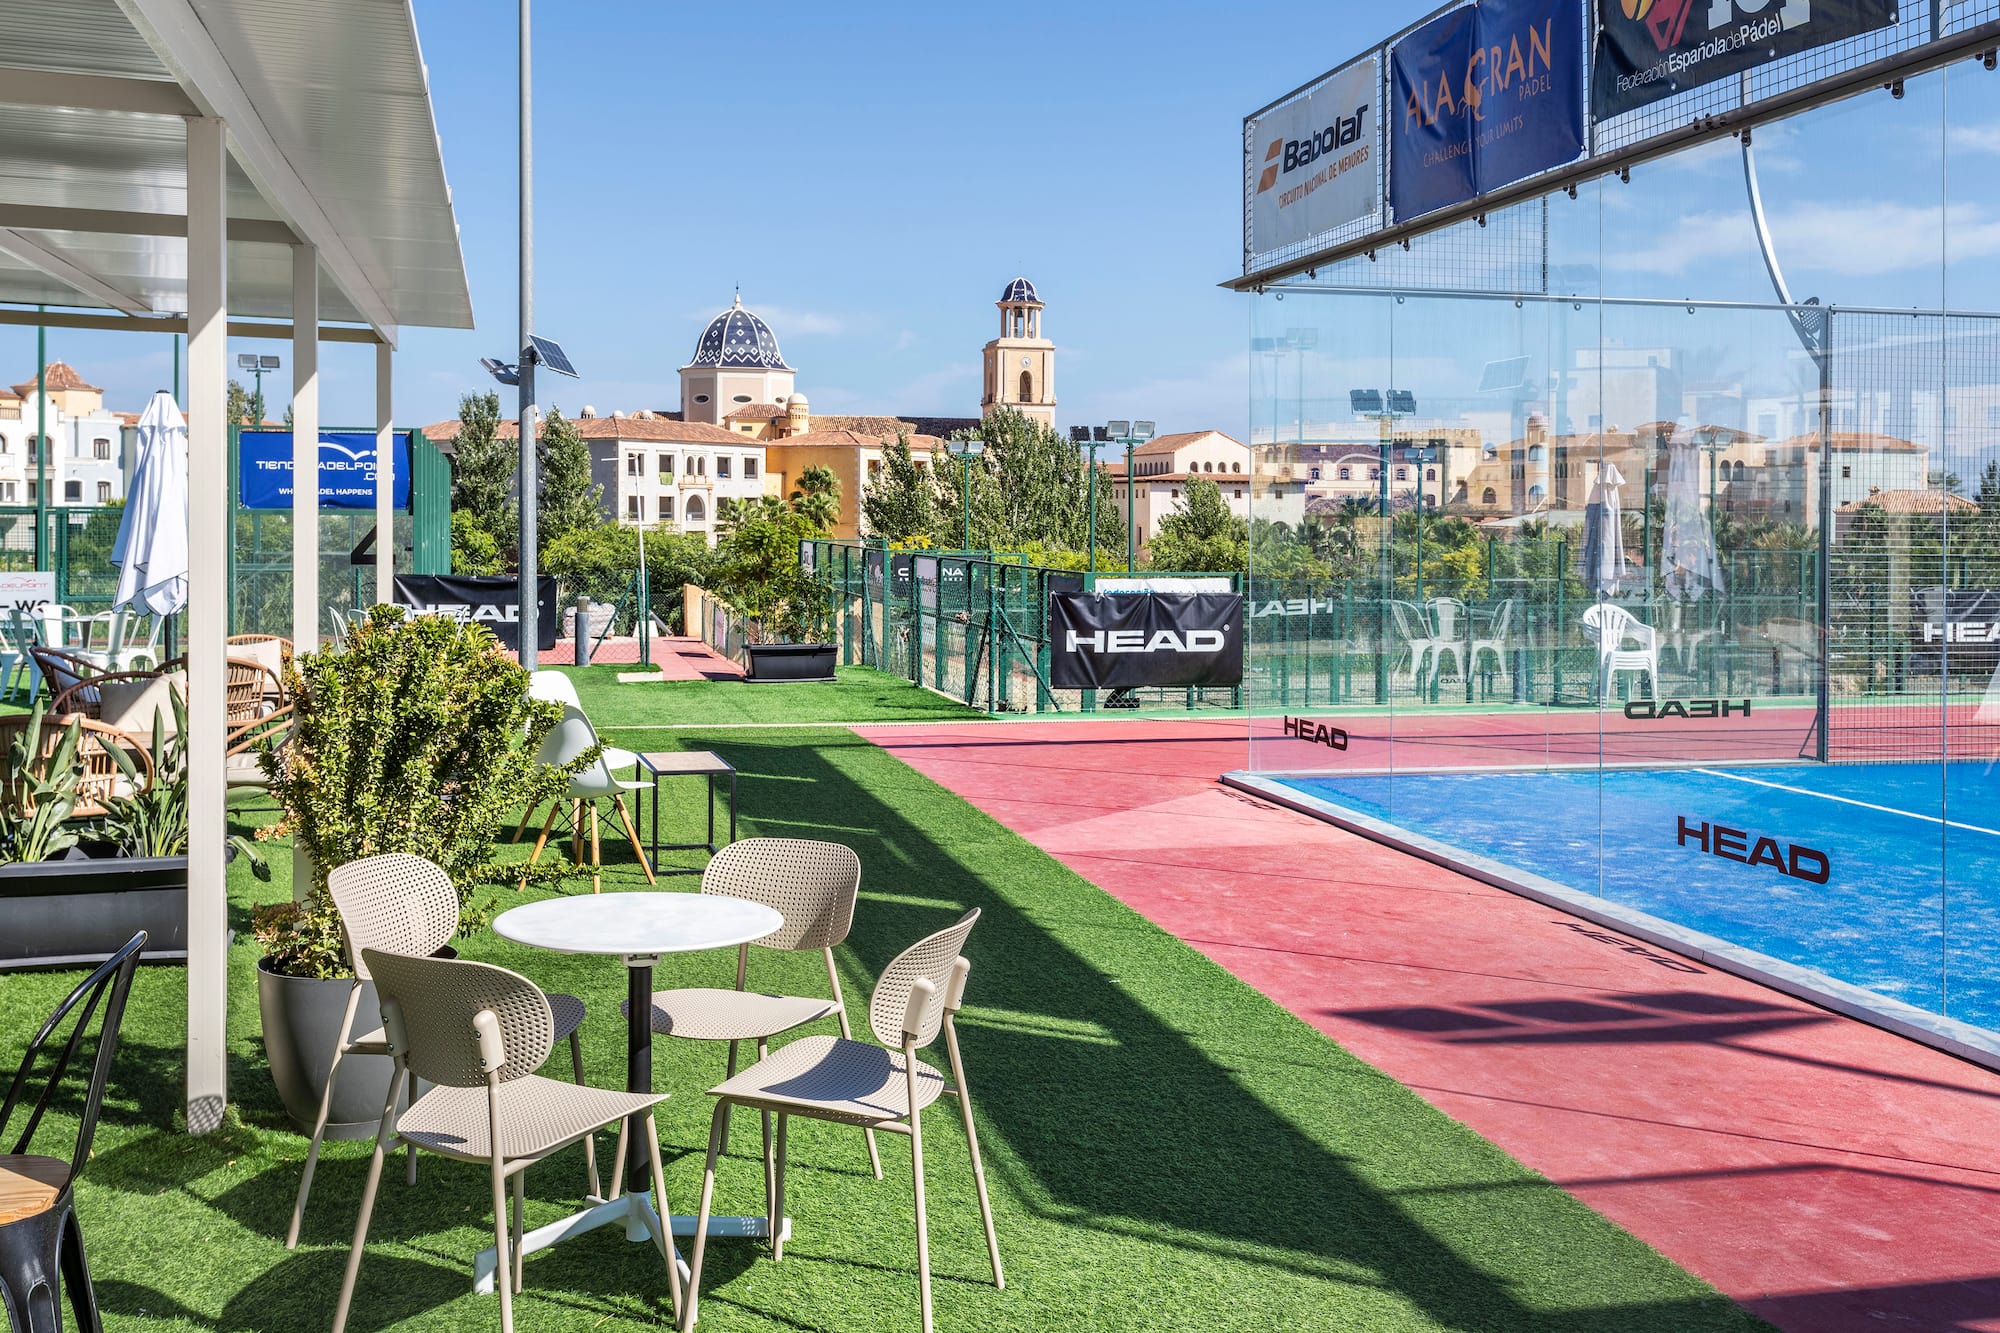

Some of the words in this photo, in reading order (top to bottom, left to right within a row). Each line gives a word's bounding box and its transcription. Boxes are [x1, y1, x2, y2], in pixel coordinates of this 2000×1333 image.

[1519, 73, 1551, 102] PADEL
[1423, 139, 1472, 168] CHALLENGE
[1475, 128, 1494, 149] YOUR
[1496, 115, 1523, 140] LIMITS
[1278, 184, 1303, 209] CIRCUITO
[1329, 162, 1337, 180] DE
[1339, 145, 1369, 175] MENORES
[1066, 629, 1225, 653] HEAD
[1284, 715, 1348, 751] HEAD
[1677, 815, 1830, 885] HEAD
